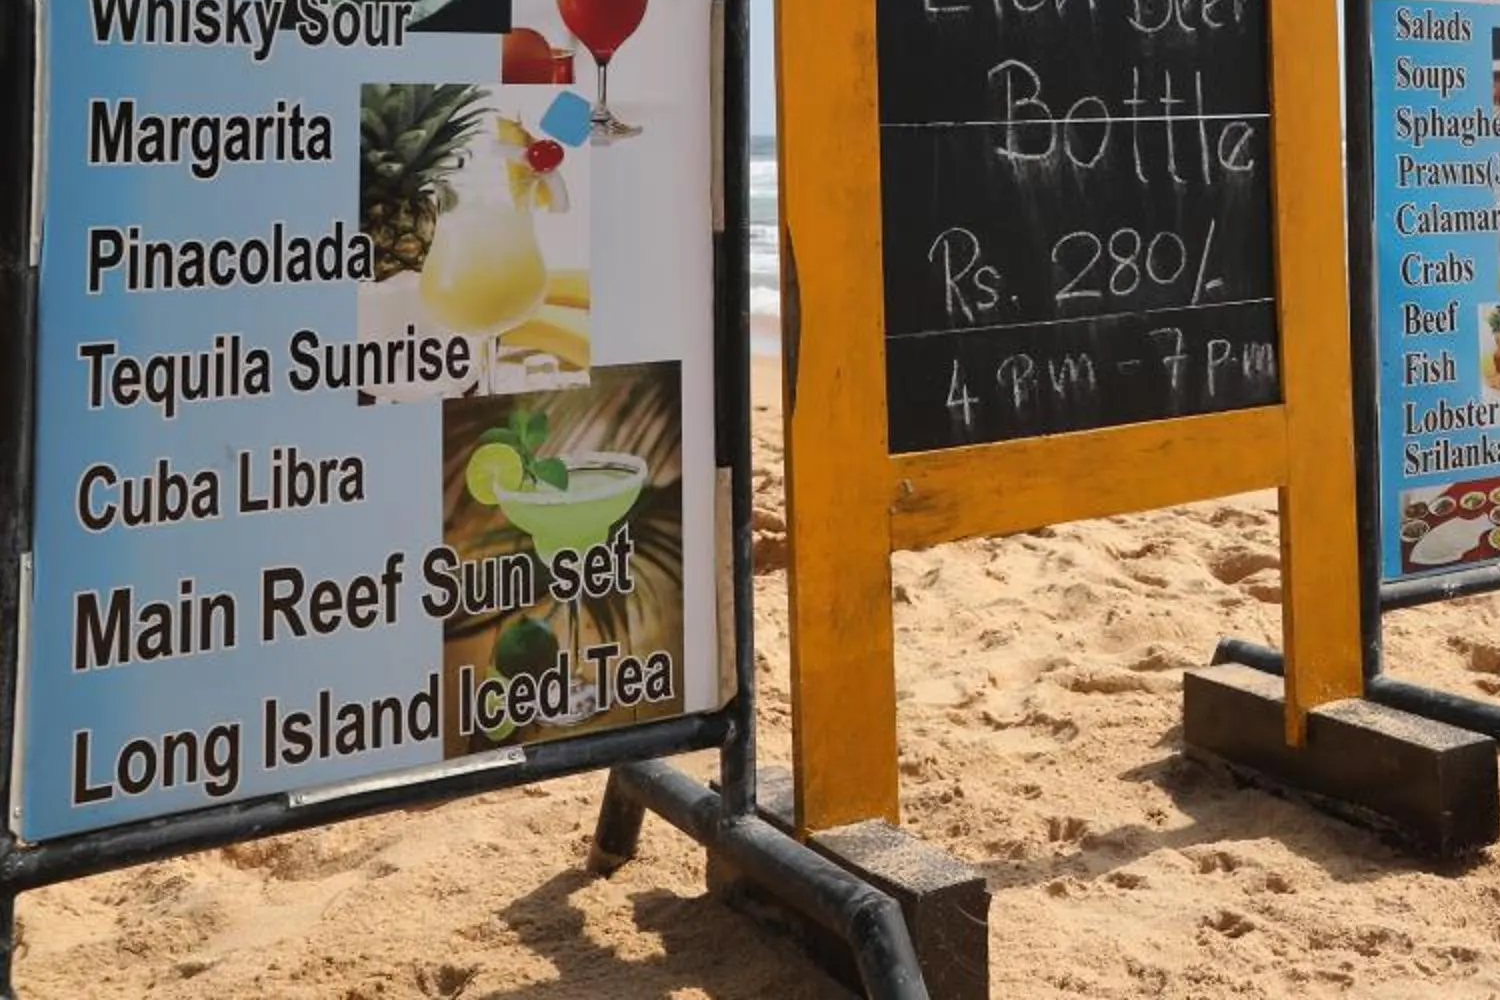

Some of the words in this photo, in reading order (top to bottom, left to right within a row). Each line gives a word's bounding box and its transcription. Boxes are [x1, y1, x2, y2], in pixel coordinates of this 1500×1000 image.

[1396, 7, 1472, 42] Salads
[1396, 56, 1467, 98] Soups
[89, 99, 332, 178] Margarita
[987, 59, 1255, 185] Bottle
[87, 222, 375, 293] Pinacolada
[928, 227, 1020, 322] Rs.
[1401, 252, 1475, 286] Crabs
[1404, 301, 1458, 336] Beef
[80, 335, 271, 419] Tequila
[288, 325, 471, 392] Sunrise
[947, 359, 979, 425] 4
[1149, 327, 1189, 389] 7
[1405, 352, 1456, 387] Fish
[1405, 401, 1499, 436] Lobster
[77, 459, 220, 531] Cuba
[238, 448, 364, 513] Libra
[73, 580, 237, 671] Main
[262, 553, 405, 643] Reef
[422, 545, 533, 619] Sun
[550, 522, 635, 600] set
[71, 716, 241, 808] Long
[264, 674, 441, 768] Island
[460, 661, 569, 737] Iced
[586, 644, 673, 710] Tea
